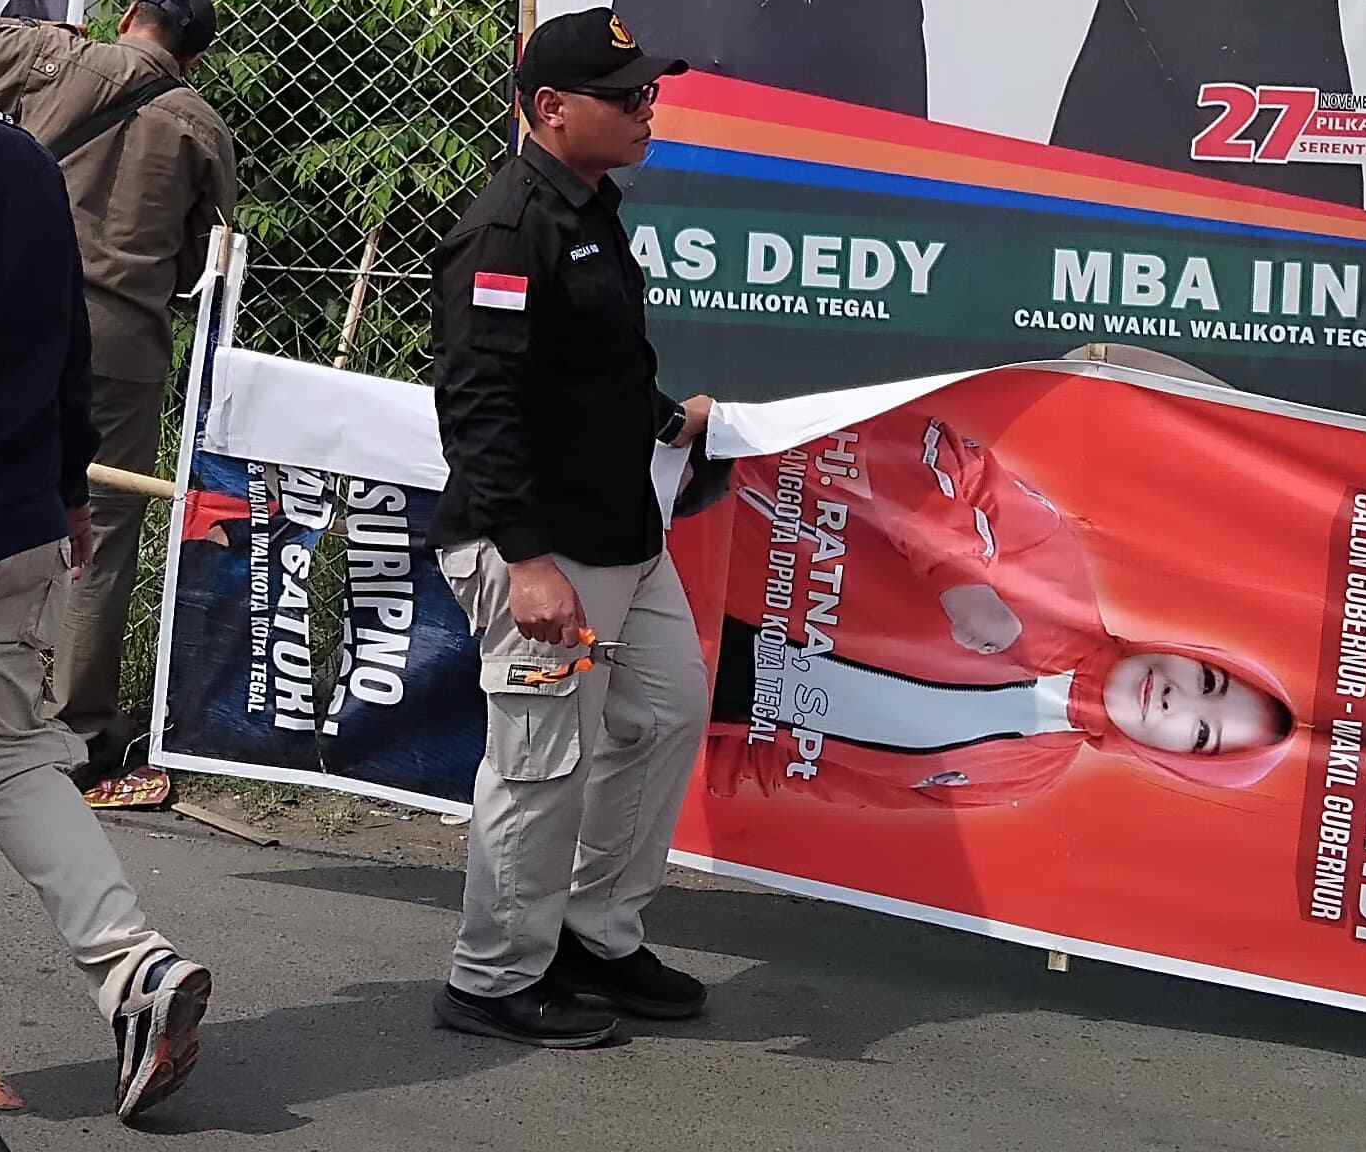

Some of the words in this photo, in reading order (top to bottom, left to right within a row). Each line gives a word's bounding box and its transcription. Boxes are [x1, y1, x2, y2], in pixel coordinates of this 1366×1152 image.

[1191, 82, 1320, 164] 27
[630, 225, 716, 281] AS
[746, 231, 947, 294] DEDY
[1052, 250, 1222, 312] MBA
[1251, 259, 1362, 319] IIN
[643, 287, 681, 306] ON
[689, 289, 809, 314] WALIKOTA
[816, 297, 890, 319] TEGAL
[1015, 310, 1095, 334] CALON
[1104, 313, 1181, 338] WAKIL
[1189, 318, 1316, 346] WALIKOTA
[247, 462, 265, 474] &
[815, 430, 859, 486] Hj.
[249, 480, 269, 527] WAKIL
[771, 448, 809, 543] ANGGOTA
[250, 532, 269, 616] WALIKOTA
[346, 479, 413, 706] SURIPNO
[765, 549, 796, 609] DPRD
[792, 500, 848, 672] RATNA,
[250, 617, 268, 657] KOTA
[756, 613, 789, 670] KOTA
[247, 662, 268, 714] TEGAL
[747, 677, 783, 745] TEGAL
[786, 684, 829, 780] S.Pt
[1325, 719, 1363, 789] WAKIL
[1310, 795, 1354, 922] GUBERNUR
